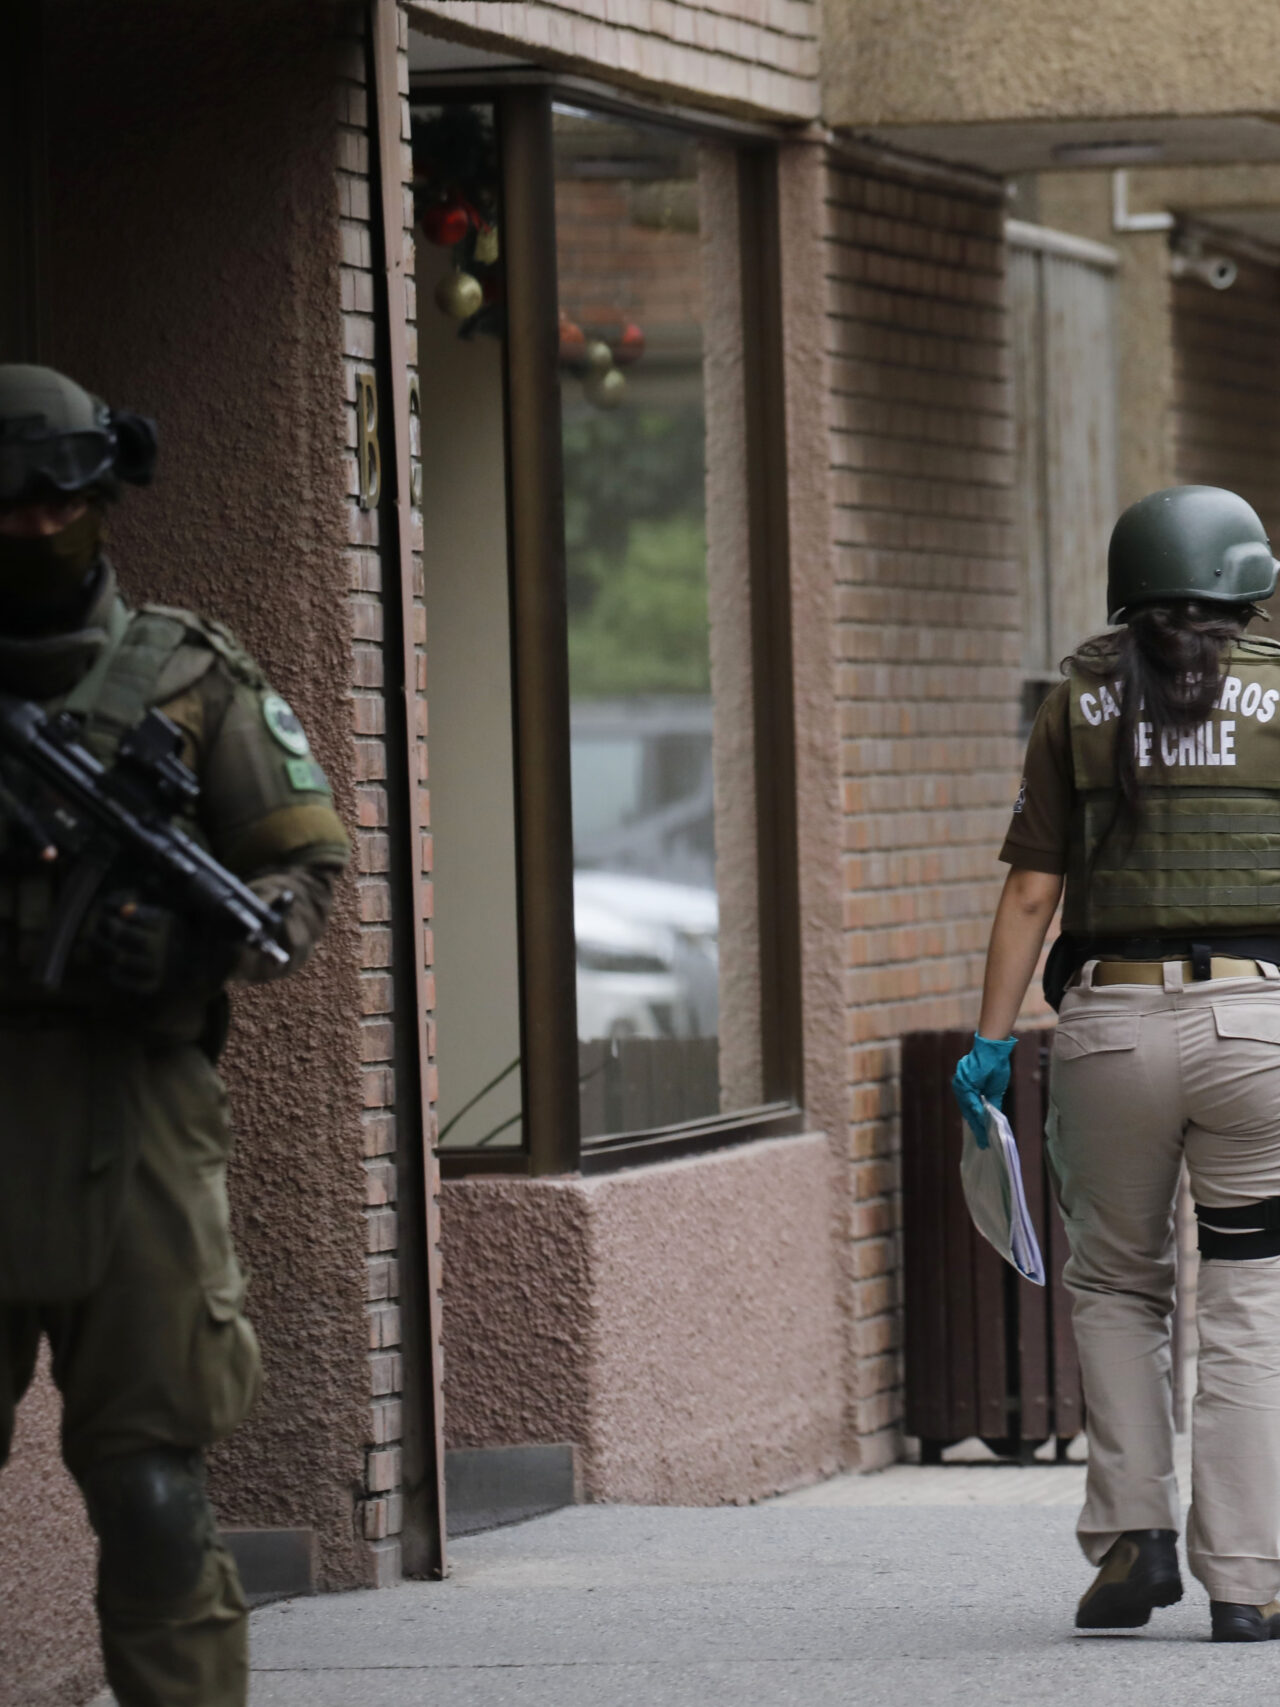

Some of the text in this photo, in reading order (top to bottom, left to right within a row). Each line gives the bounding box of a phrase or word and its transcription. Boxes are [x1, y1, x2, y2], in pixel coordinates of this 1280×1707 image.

[355, 372, 381, 509] B
[1133, 720, 1236, 767] E CHILE
